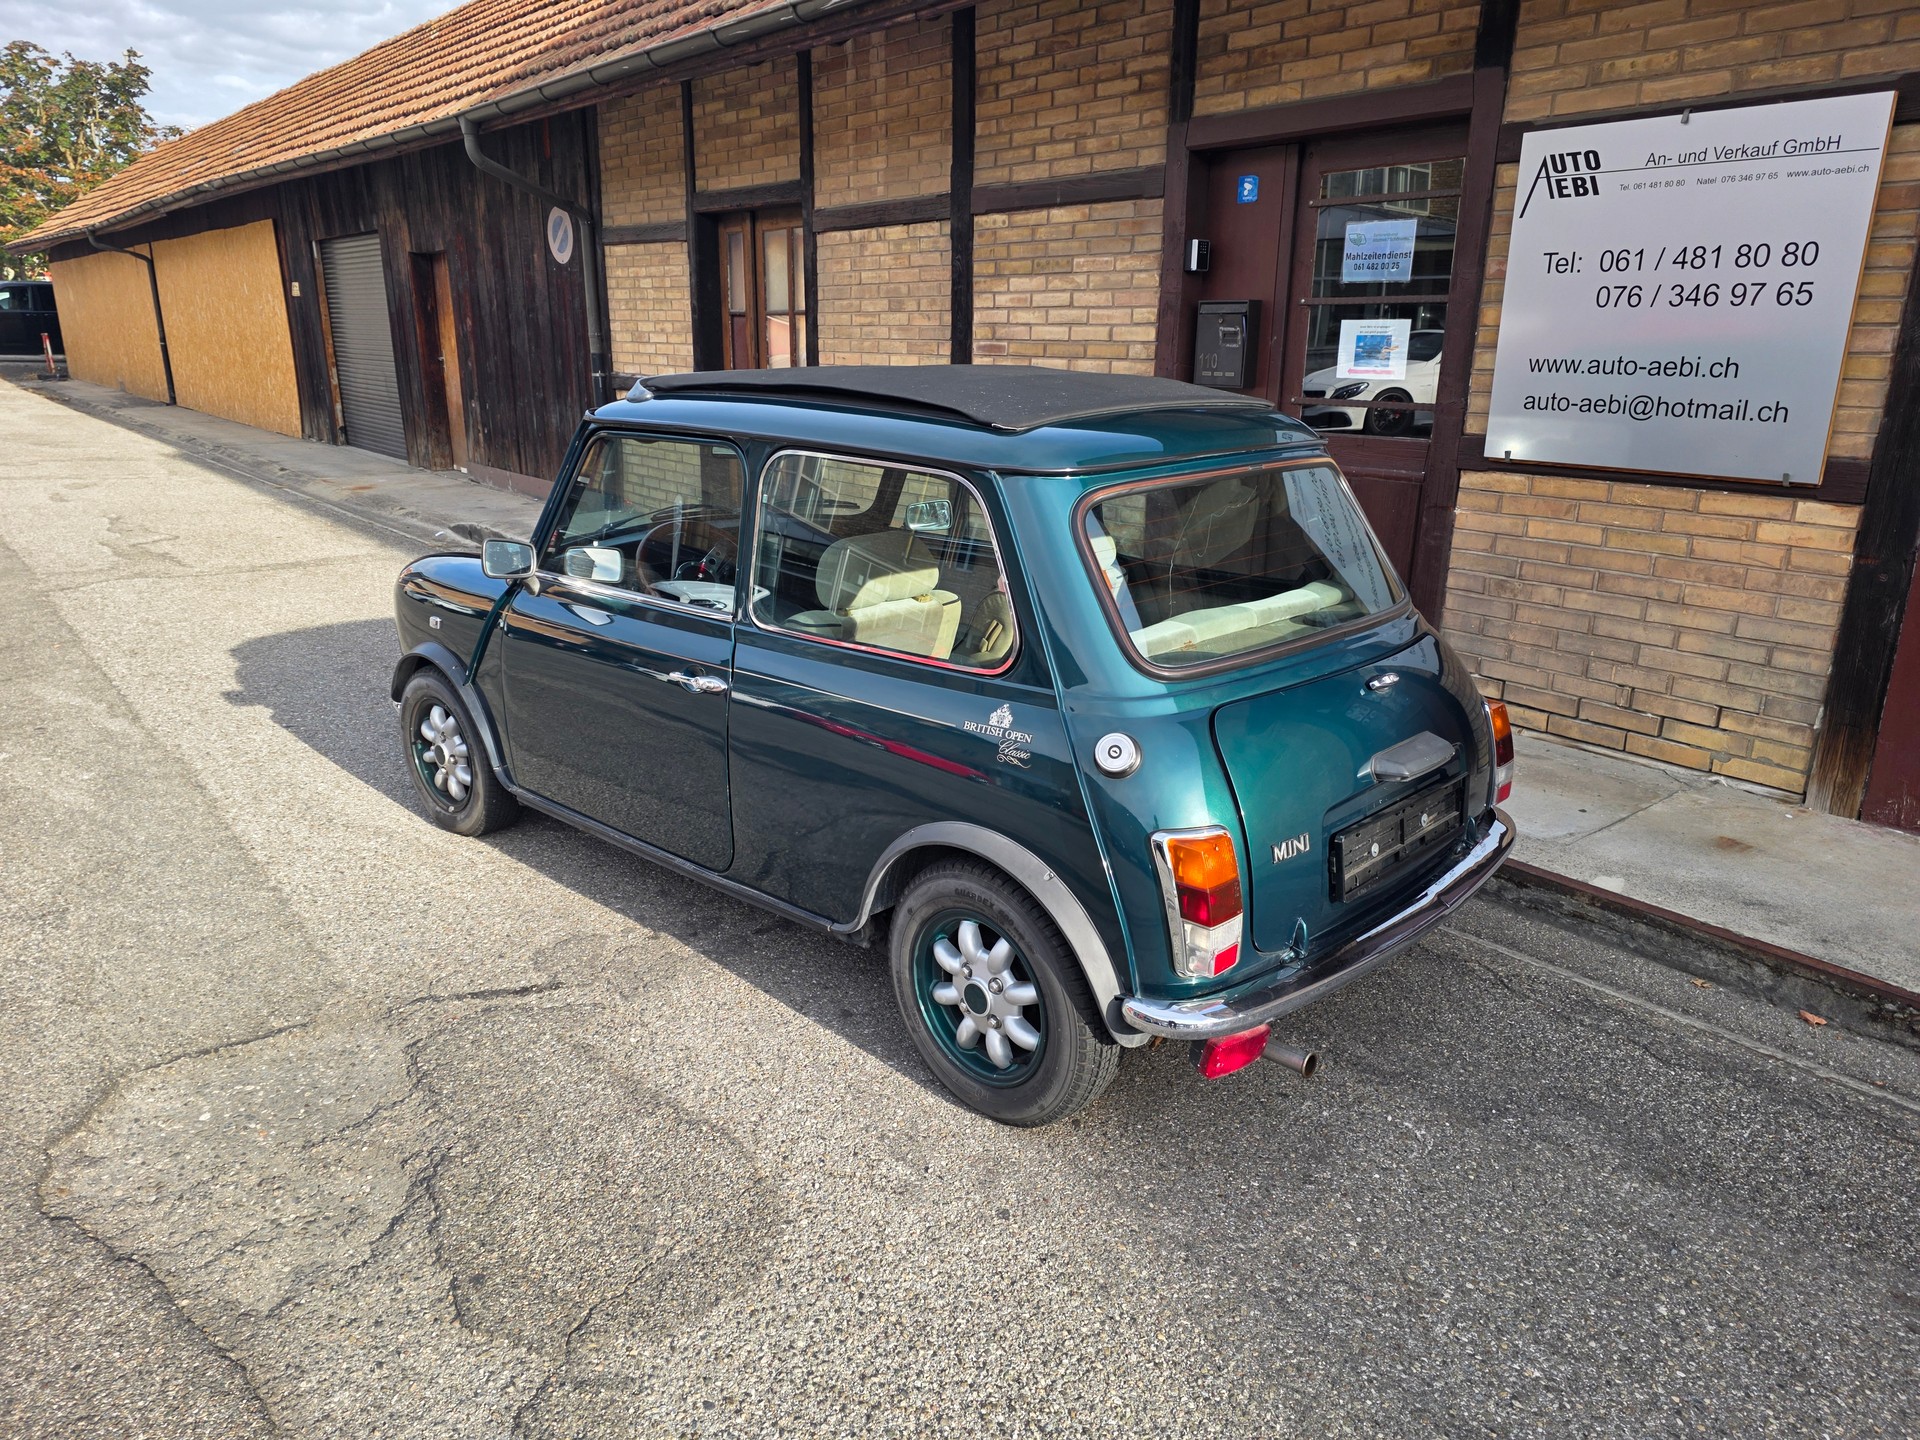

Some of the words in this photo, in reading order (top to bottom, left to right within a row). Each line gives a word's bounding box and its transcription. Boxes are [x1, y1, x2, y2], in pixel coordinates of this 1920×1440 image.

[1645, 152, 1672, 167] An-
[1678, 147, 1708, 164] und
[1713, 140, 1779, 161] Verkauf
[1783, 134, 1842, 155] GmbH
[1633, 181, 1646, 191] 061
[1648, 180, 1662, 189] 481
[1664, 179, 1674, 188] 80
[1675, 179, 1686, 187] 80
[1721, 175, 1736, 184] 076
[1738, 174, 1754, 183] 346
[1755, 172, 1766, 181] 97
[1767, 171, 1779, 180] 65
[1786, 163, 1870, 178] www.auto-aebi.ch
[1345, 250, 1412, 261] Mahlzeitendienst
[1353, 263, 1364, 271] 061
[1366, 262, 1379, 271] 482
[1380, 262, 1390, 270] 00
[1391, 261, 1400, 270] 25
[1543, 251, 1582, 274] Tel:
[1600, 248, 1644, 273] 061
[1654, 246, 1667, 272] /
[1672, 245, 1722, 270] 481
[1734, 243, 1771, 268] 80
[1781, 241, 1820, 267] 80
[1596, 285, 1643, 309] 076
[1649, 283, 1662, 308] /
[1669, 283, 1720, 307] 346
[1730, 282, 1767, 307] 97
[1776, 281, 1814, 307] 65
[1528, 355, 1740, 379] www.auto-aebi.ch
[1523, 392, 1789, 424] auto-aebi@hotmail.ch
[963, 720, 1004, 738] BRITISH
[1005, 730, 1033, 744] OPEN
[998, 738, 1031, 760] Classic
[1270, 832, 1310, 865] MINI
